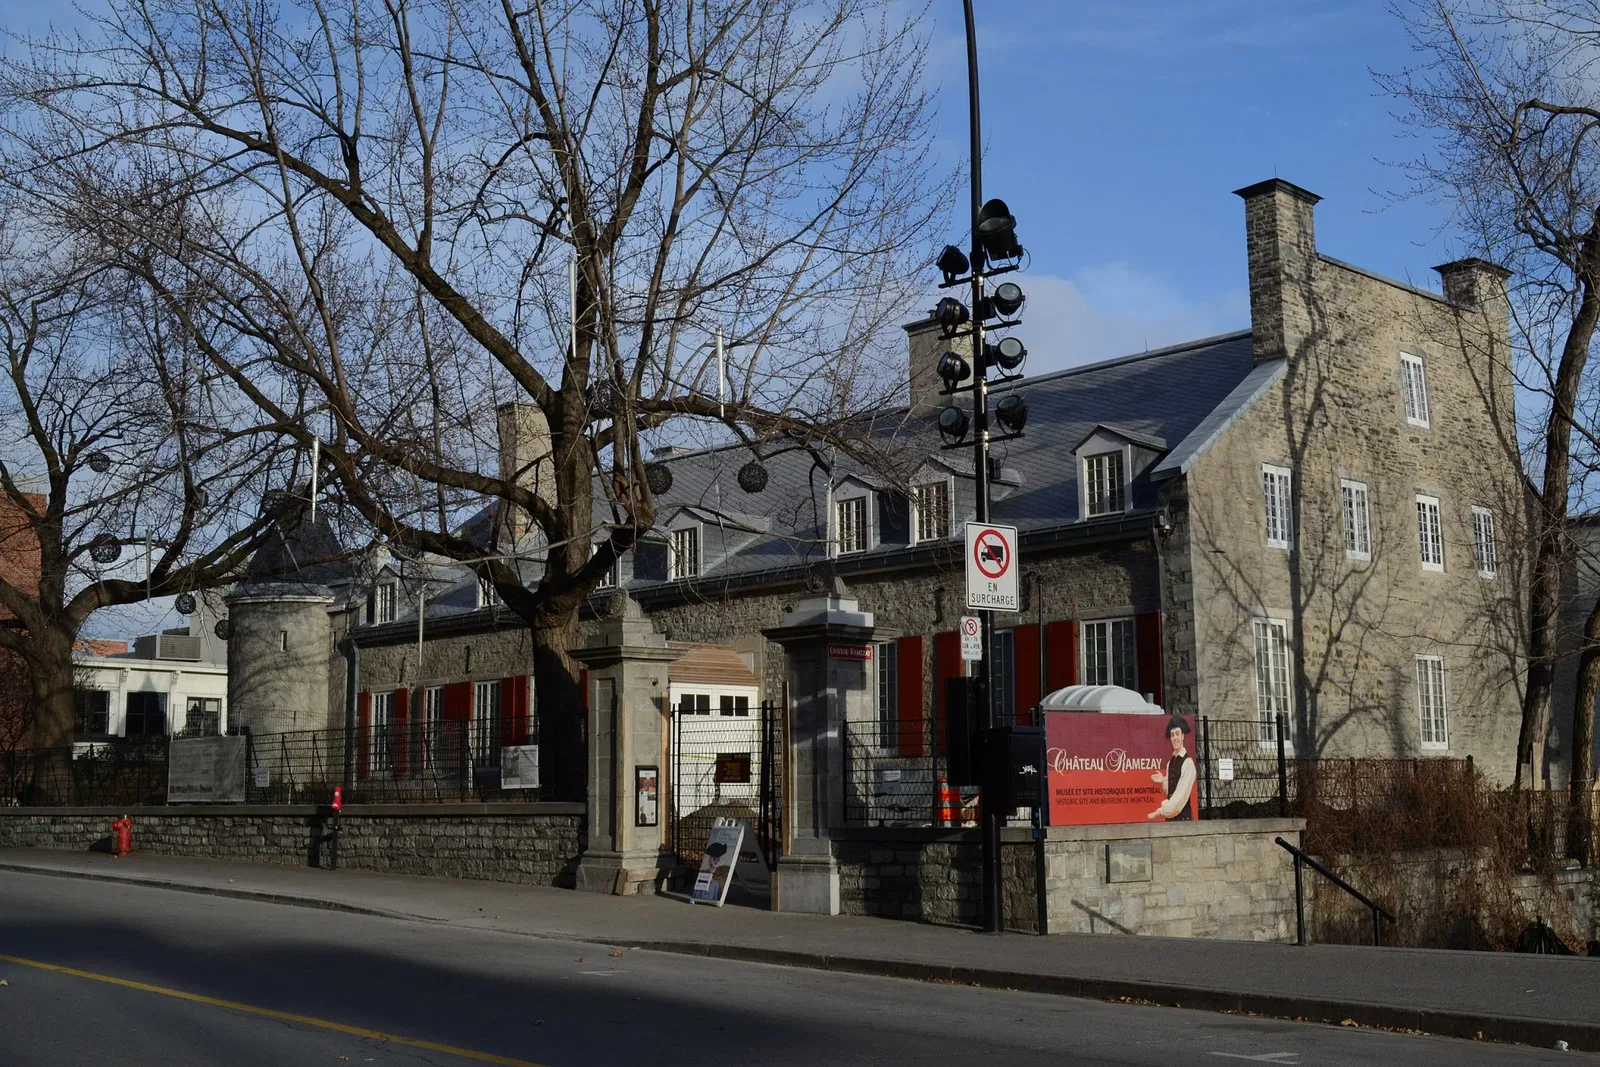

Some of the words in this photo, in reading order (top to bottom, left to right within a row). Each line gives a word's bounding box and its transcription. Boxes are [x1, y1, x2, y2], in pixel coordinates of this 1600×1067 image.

[988, 582, 998, 592] EN
[971, 593, 1015, 606] SURCHARGE
[1047, 747, 1104, 776] CHÂTEAU
[1105, 748, 1162, 773] RAMEZAY
[1056, 787, 1074, 796] MUSÉE
[1094, 788, 1126, 797] HISTORIQUE
[1134, 786, 1162, 794] MONTRÉAL
[1130, 796, 1155, 804] MONTRÉAL
